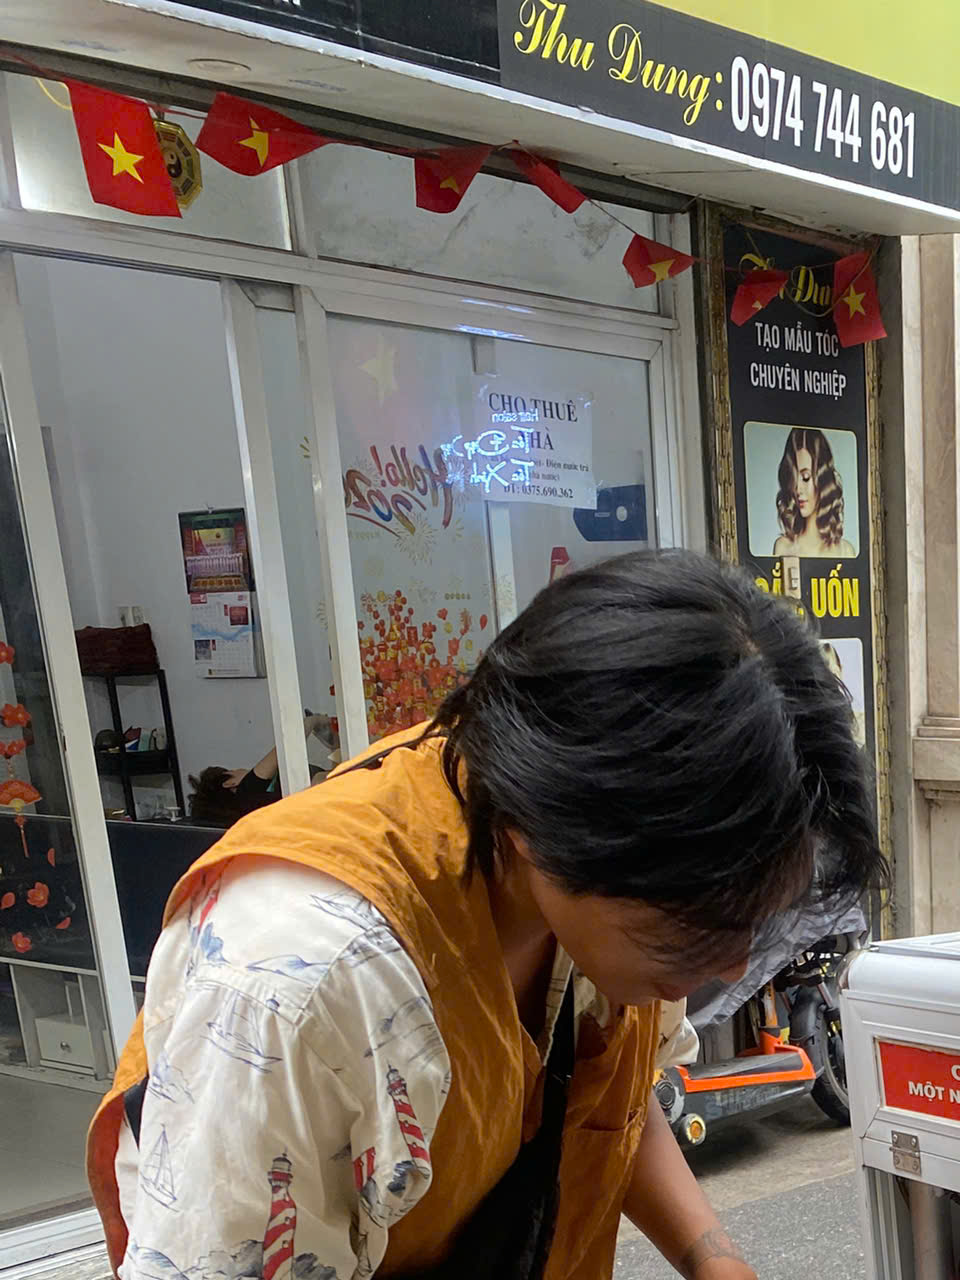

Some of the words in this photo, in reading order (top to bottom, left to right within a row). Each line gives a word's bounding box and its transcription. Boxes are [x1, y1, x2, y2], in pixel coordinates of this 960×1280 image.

[514, 0, 595, 71] Thu
[608, 23, 724, 125] Dung:
[731, 56, 803, 146] 0974
[813, 81, 863, 162] 744
[871, 101, 914, 178] 681
[755, 322, 780, 352] TẠO
[785, 321, 812, 356] MẪU
[816, 329, 839, 357] TÓC
[750, 363, 800, 391] CHUYÊN
[804, 370, 846, 400] NGHIỆP
[489, 392, 527, 413] CHO
[530, 399, 578, 422] THUÊ
[810, 563, 860, 618] UỐN
[908, 1080, 944, 1102] MỘT
